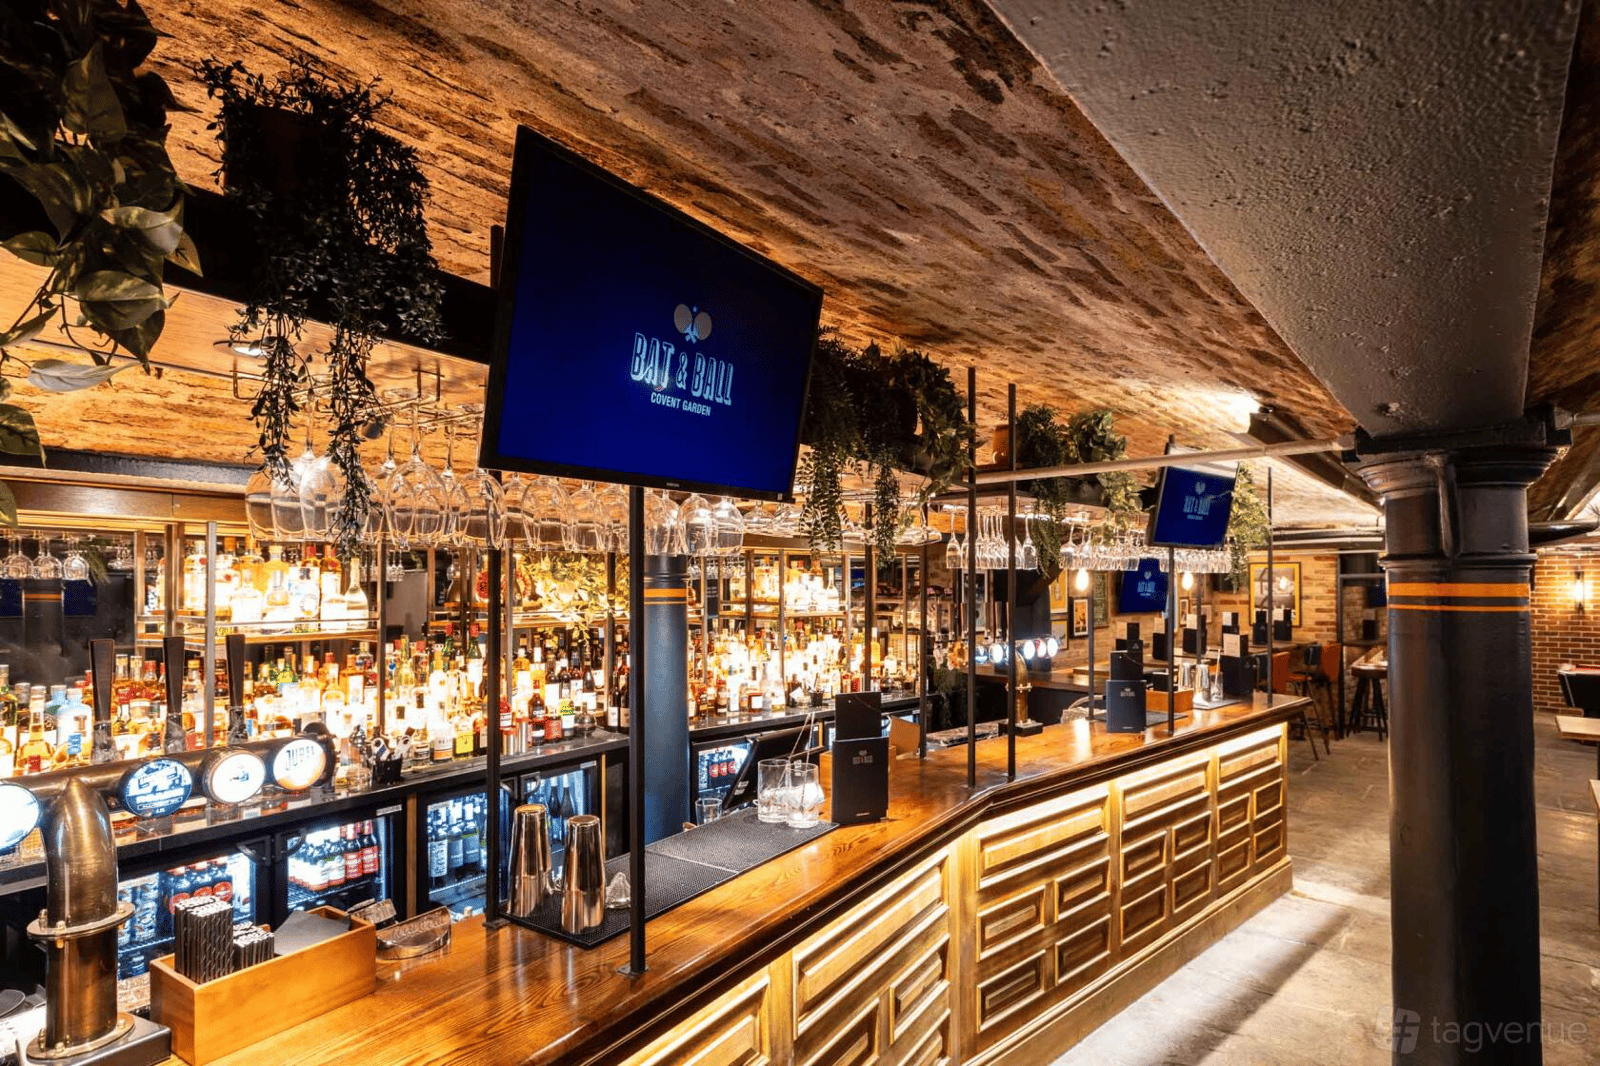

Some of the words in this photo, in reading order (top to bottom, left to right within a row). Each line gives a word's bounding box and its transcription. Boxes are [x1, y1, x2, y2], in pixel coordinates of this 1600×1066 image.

[631, 332, 675, 389] BAT
[676, 351, 688, 390] &
[691, 352, 734, 406] BALL
[651, 392, 681, 409] COVENT
[682, 400, 711, 416] GARDEN
